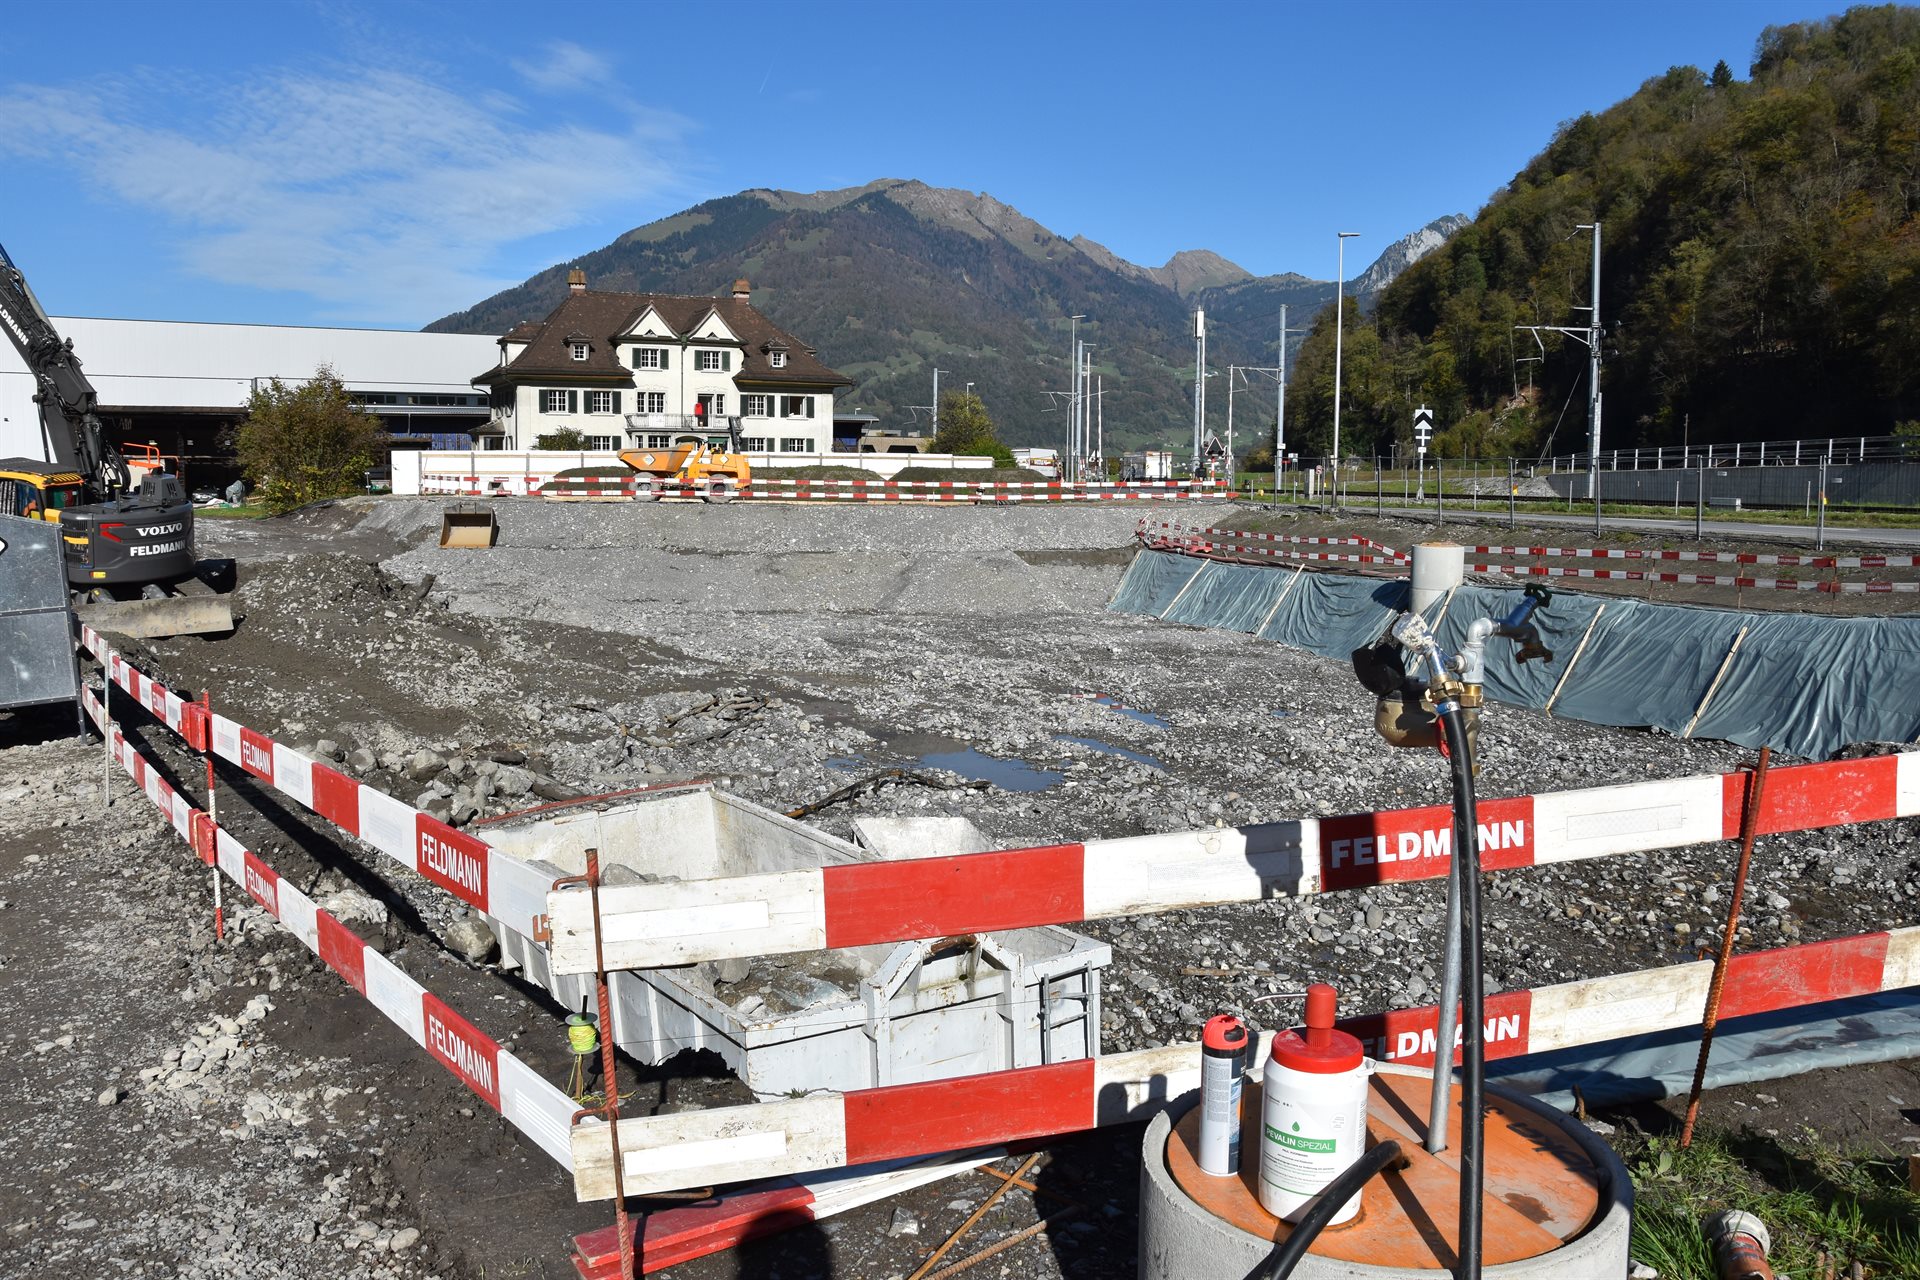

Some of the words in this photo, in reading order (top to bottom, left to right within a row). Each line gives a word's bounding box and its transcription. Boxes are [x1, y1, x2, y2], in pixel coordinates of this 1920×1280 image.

[130, 540, 185, 557] FELDMANN
[136, 523, 182, 537] VOLVO
[243, 740, 271, 776] FELDMANN
[422, 831, 481, 896] FELDMANN
[1331, 820, 1524, 869] FELDMNN
[247, 864, 276, 911] FELDMANN
[429, 1013, 493, 1094] FELDMANN
[1266, 1127, 1296, 1146] PEVALIN
[1297, 1140, 1333, 1151] SPEZIAL
